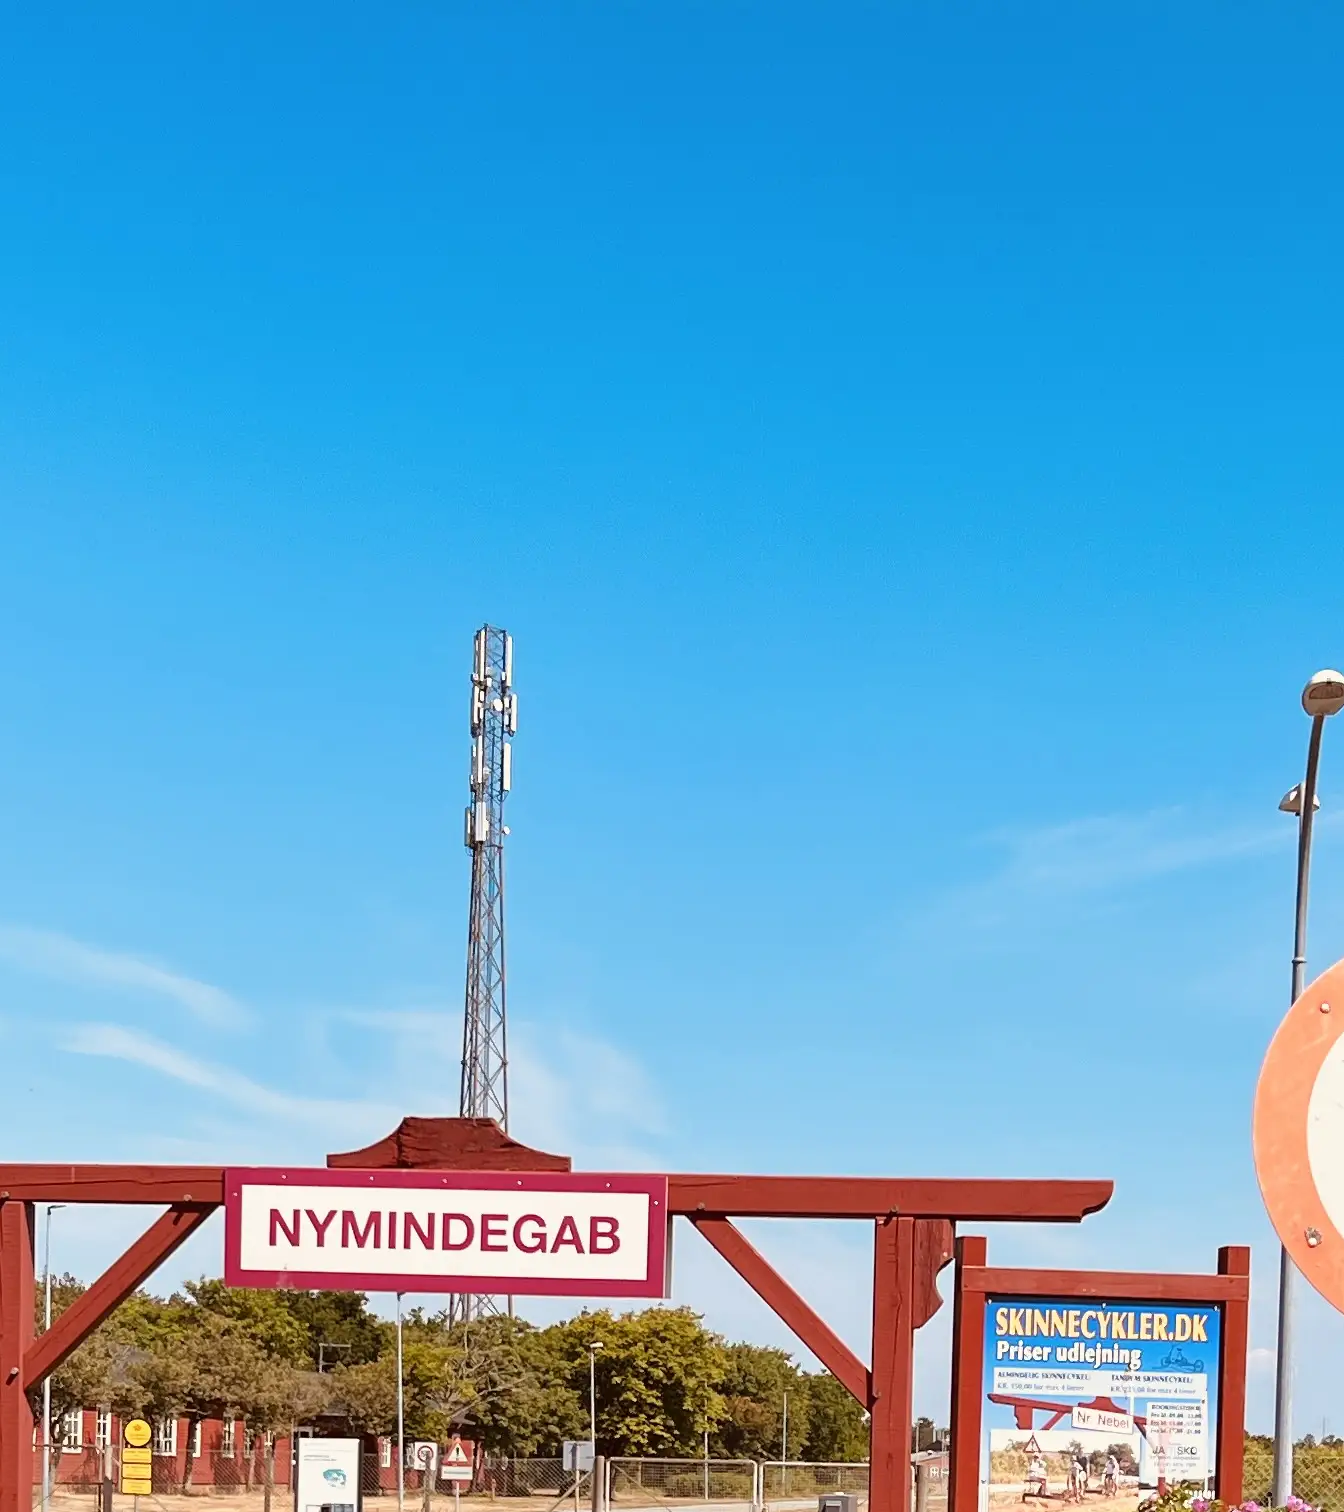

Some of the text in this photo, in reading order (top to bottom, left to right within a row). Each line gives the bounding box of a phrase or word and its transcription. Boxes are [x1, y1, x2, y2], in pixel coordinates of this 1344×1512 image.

[268, 1208, 621, 1255] NYMINDEGAB
[994, 1307, 1209, 1342] SKINNECYKLER.DK
[995, 1340, 1143, 1371] Priser udlejning
[1077, 1411, 1130, 1429] Nr Nebel
